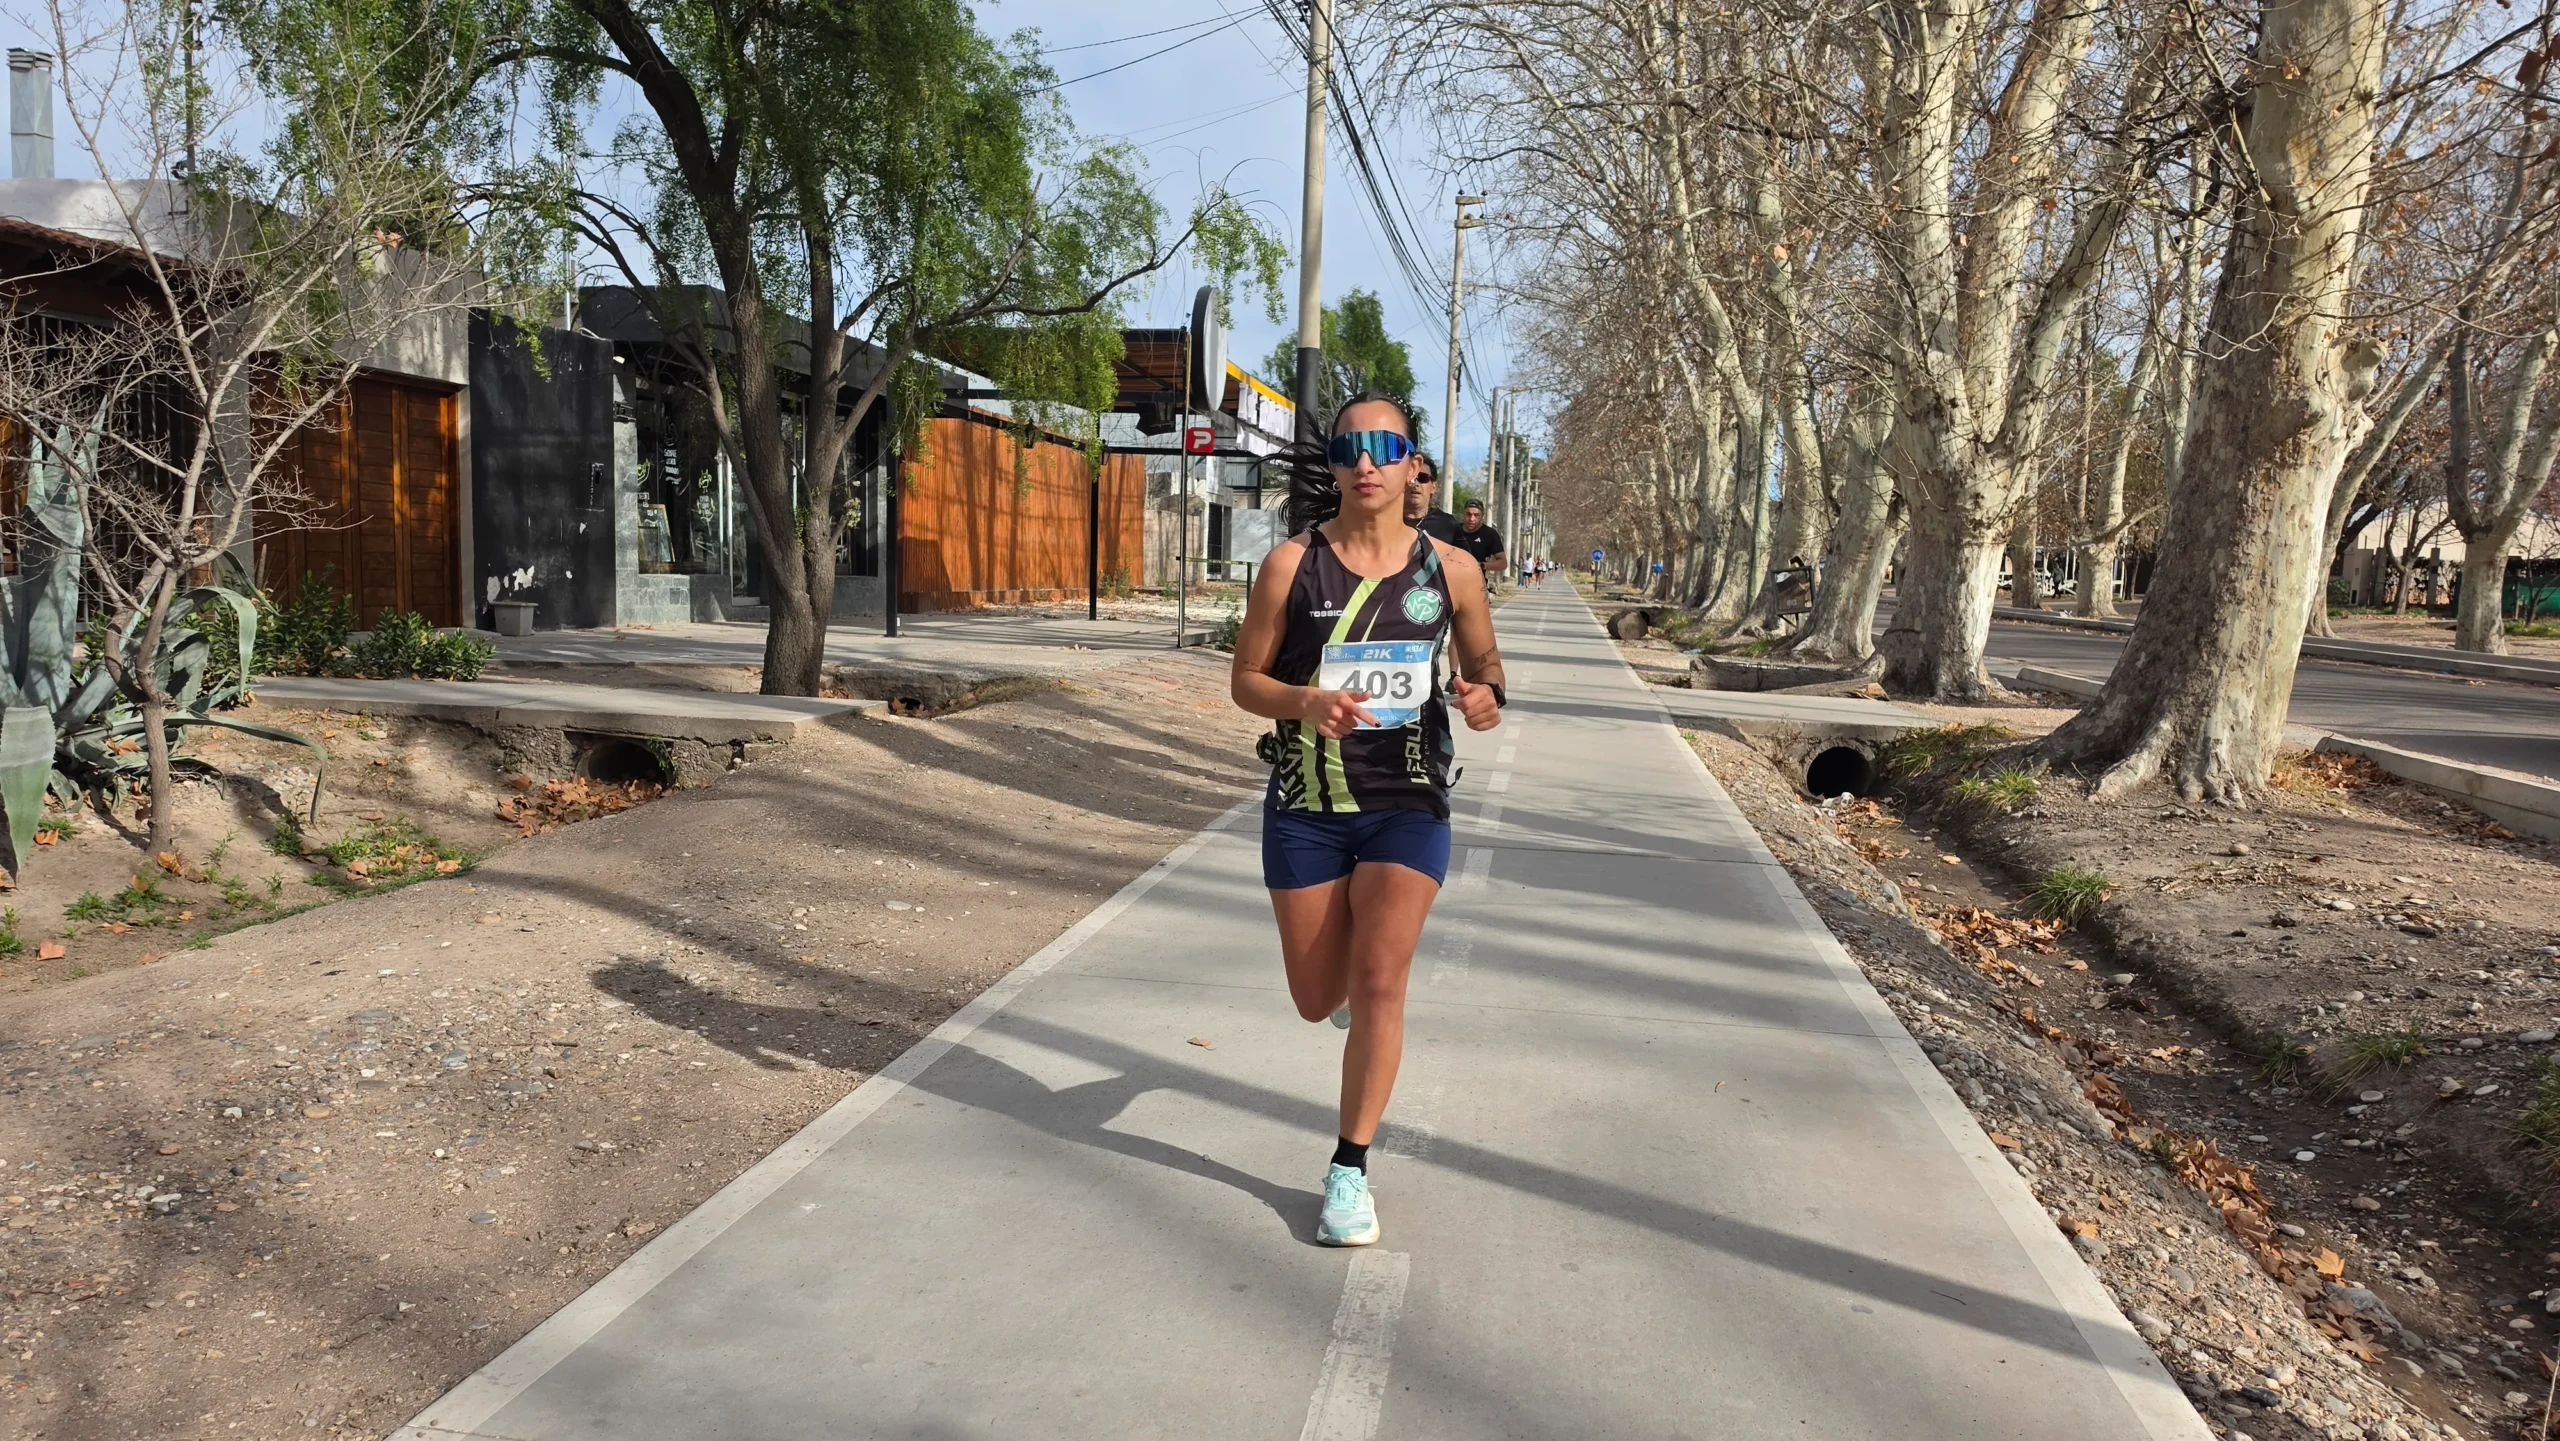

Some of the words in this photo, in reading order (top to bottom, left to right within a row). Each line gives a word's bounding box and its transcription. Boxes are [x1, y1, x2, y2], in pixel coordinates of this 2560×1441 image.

[1193, 431, 1211, 449] P
[1362, 648, 1394, 660] 21K
[1340, 669, 1413, 700] 403
